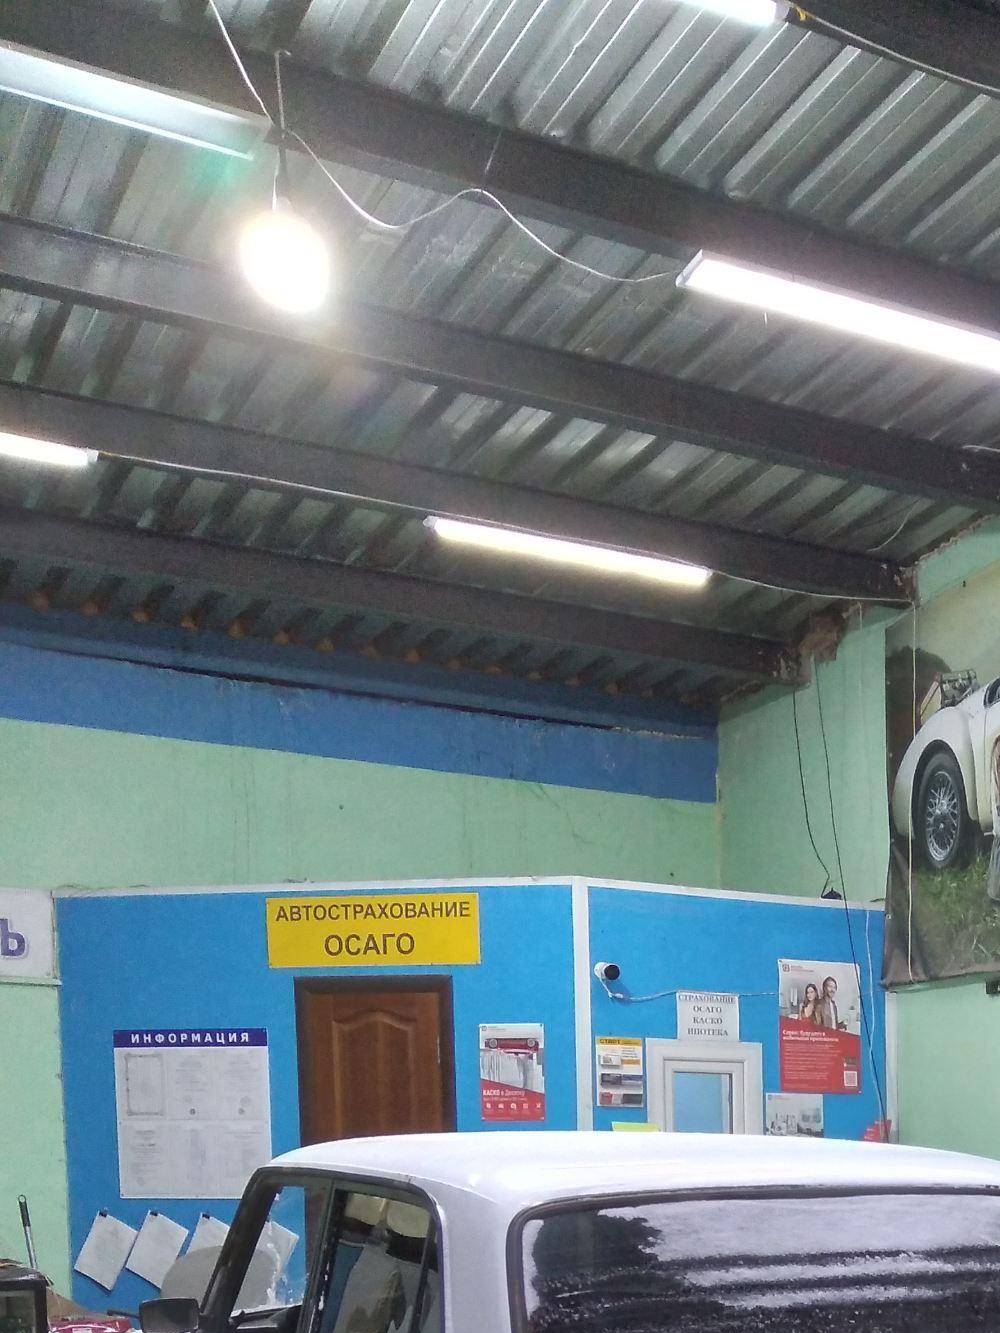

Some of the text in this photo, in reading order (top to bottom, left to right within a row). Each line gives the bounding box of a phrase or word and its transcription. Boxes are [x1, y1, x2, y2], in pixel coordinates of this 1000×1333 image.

[275, 901, 471, 922] АВТОСТРАХОВАНИЕ
[323, 932, 415, 957] ОСАГО
[678, 994, 736, 1004] СТРАХОВАНИЕ
[692, 1005, 723, 1013] ОСАГО
[692, 1016, 724, 1025] КАСКО
[687, 1027, 729, 1037] ИПОТЕКА
[131, 1032, 250, 1044] ИНФОРМАЦИЯ
